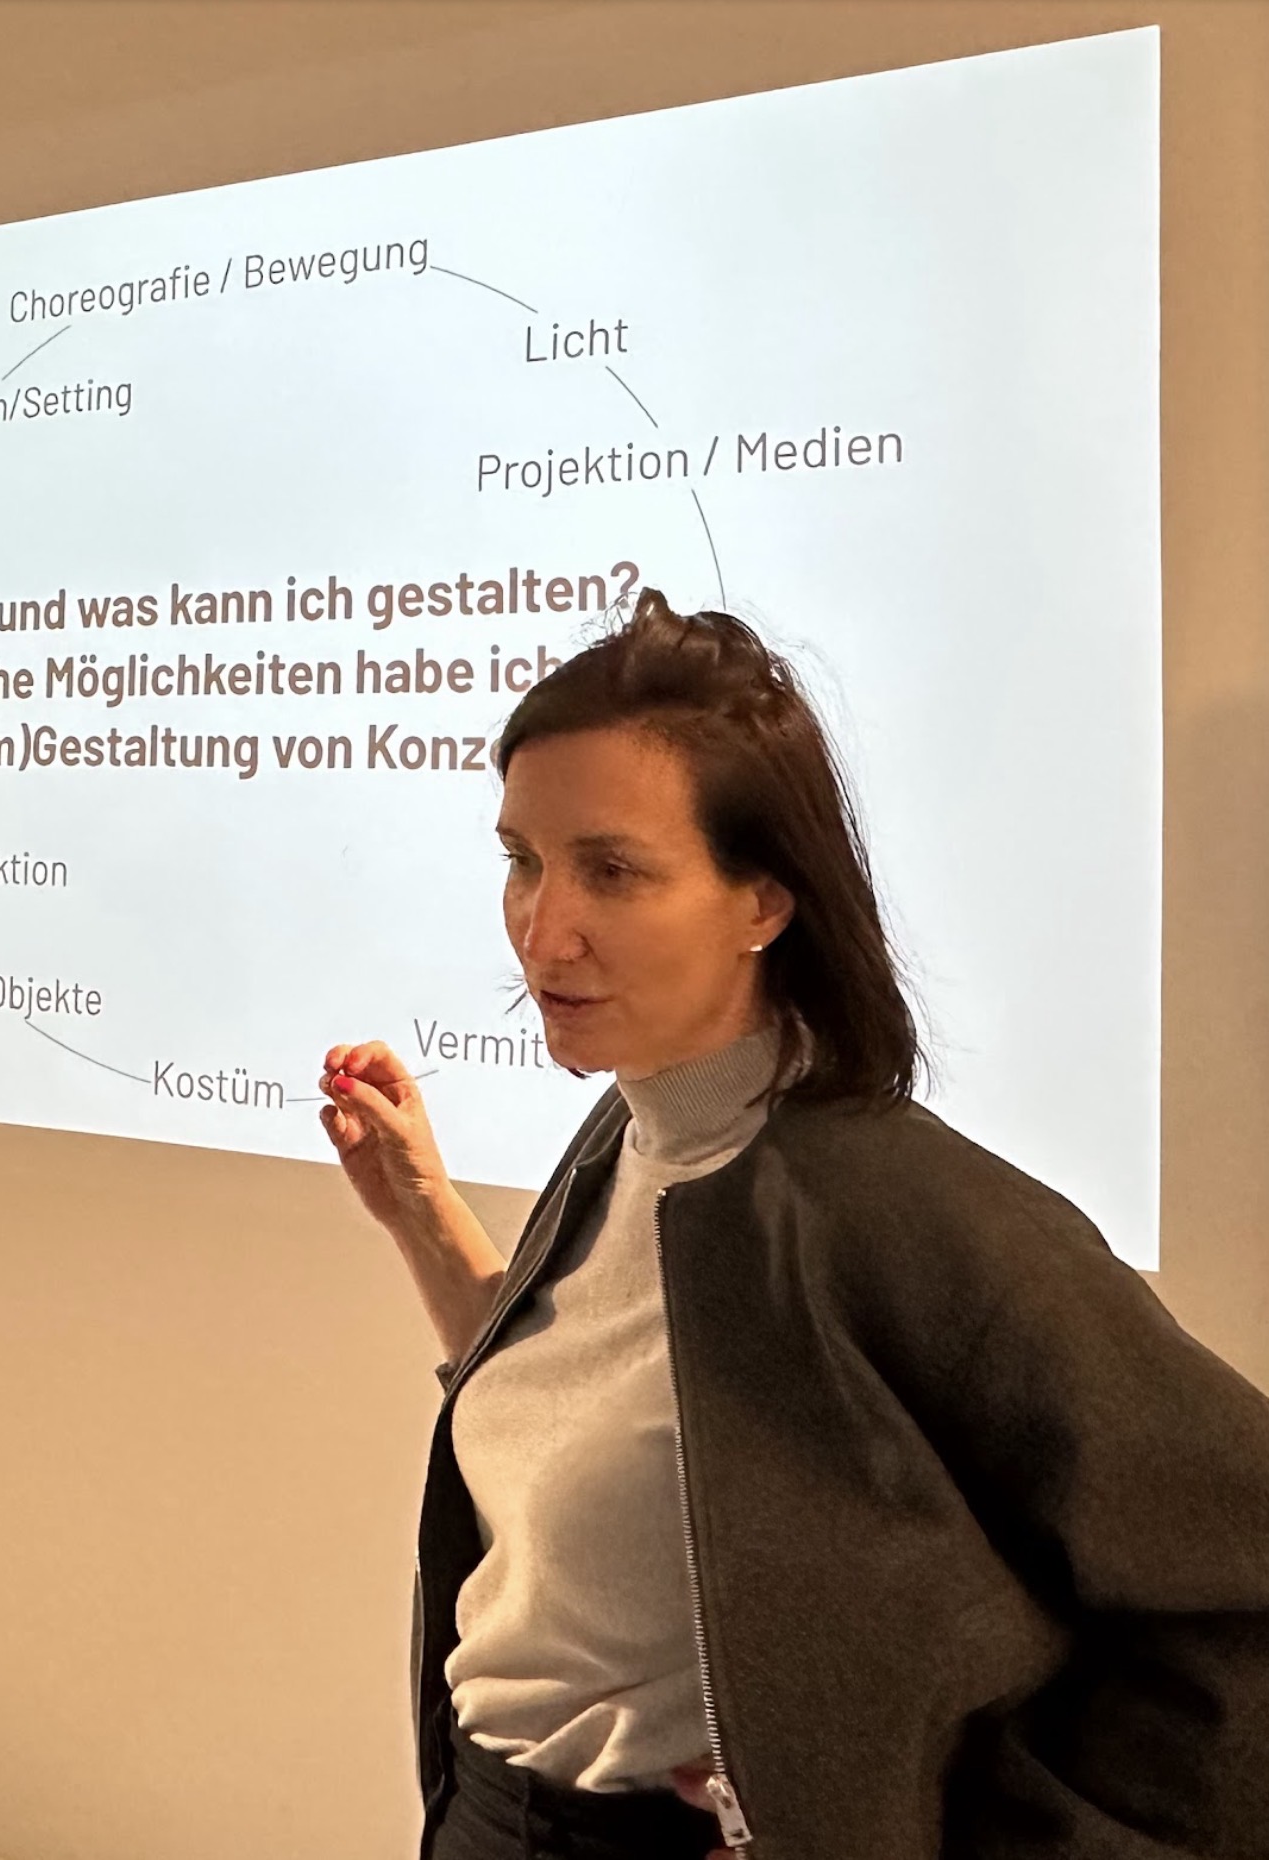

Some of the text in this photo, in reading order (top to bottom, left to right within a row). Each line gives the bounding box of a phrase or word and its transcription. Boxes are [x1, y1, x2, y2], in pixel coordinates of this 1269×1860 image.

[10, 238, 429, 323] Choreografie / Bewegung
[526, 319, 629, 363] Licht
[477, 425, 903, 498] Projektion / Medien
[77, 595, 159, 629] was
[170, 582, 272, 626] kann
[286, 575, 353, 622] ich
[367, 560, 640, 631] gestalten?
[45, 650, 342, 708] Möglichkeiten
[356, 647, 474, 694] habe
[272, 735, 352, 769] von
[414, 1018, 562, 1070] Vermit
[153, 1060, 285, 1110] Kostüm
